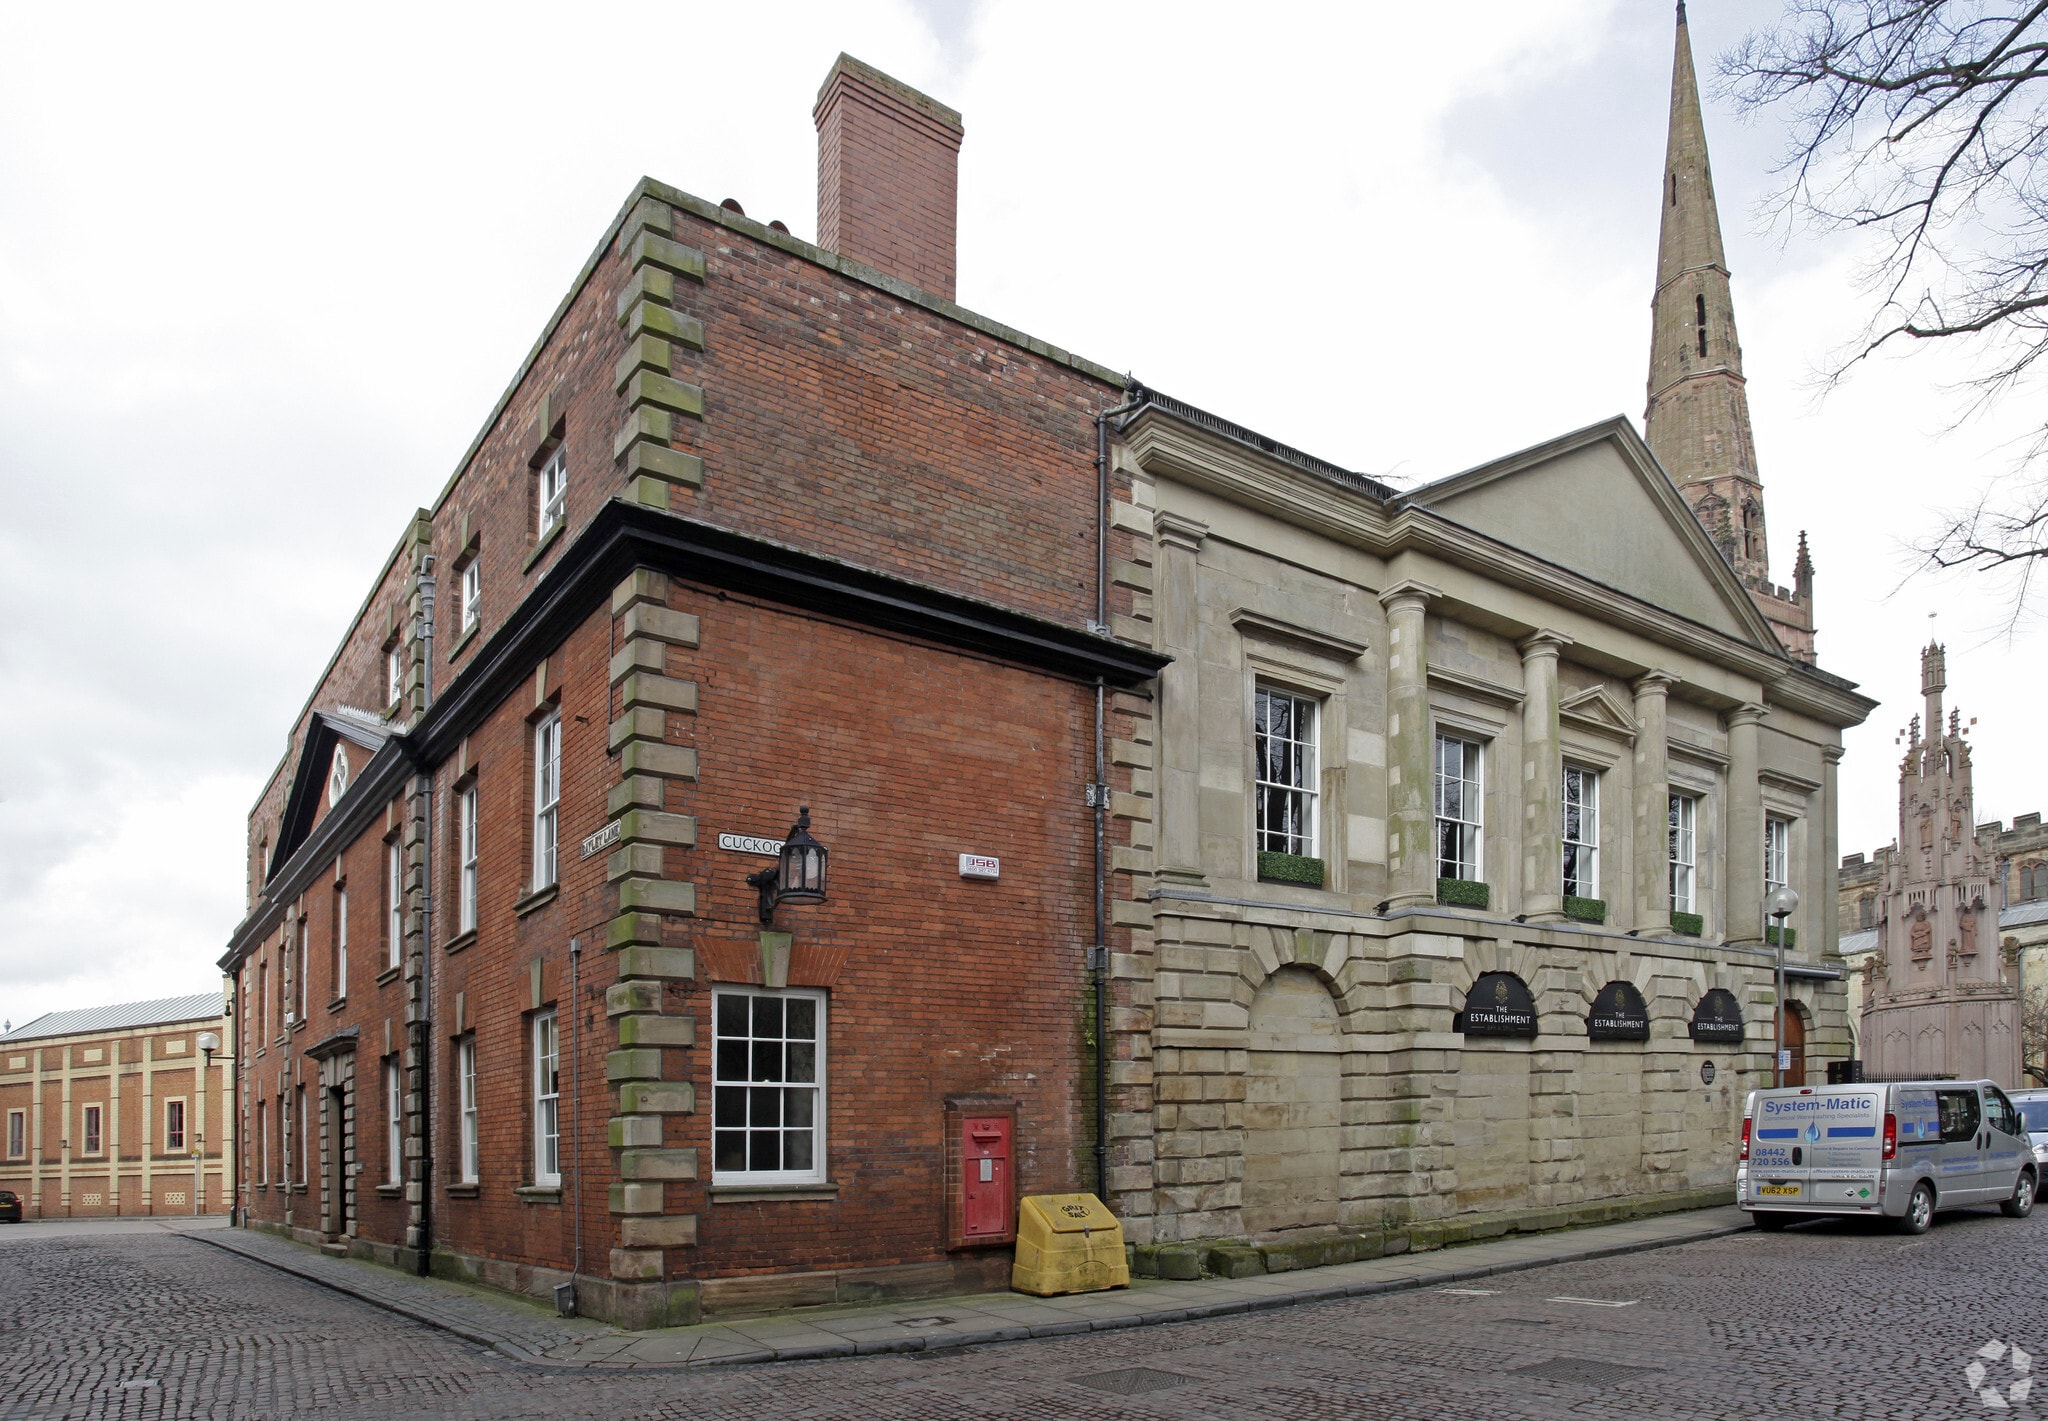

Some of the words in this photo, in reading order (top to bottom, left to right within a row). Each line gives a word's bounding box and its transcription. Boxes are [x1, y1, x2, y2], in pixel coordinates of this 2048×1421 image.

[604, 824, 620, 844] LANE
[722, 835, 782, 853] CUCKOO
[969, 858, 996, 868] JSB
[1495, 1005, 1508, 1013] THE
[1470, 1013, 1531, 1024] ESTABLISHMENT
[1615, 1011, 1625, 1019] THE
[1594, 1019, 1644, 1028] ESTABLISHMENT
[1697, 1022, 1739, 1031] ESTABLISHMENT
[1765, 1097, 1871, 1115] System-Matic
[1755, 1148, 1785, 1157] 08442
[1751, 1157, 1769, 1166] 720
[1771, 1157, 1790, 1166] 556
